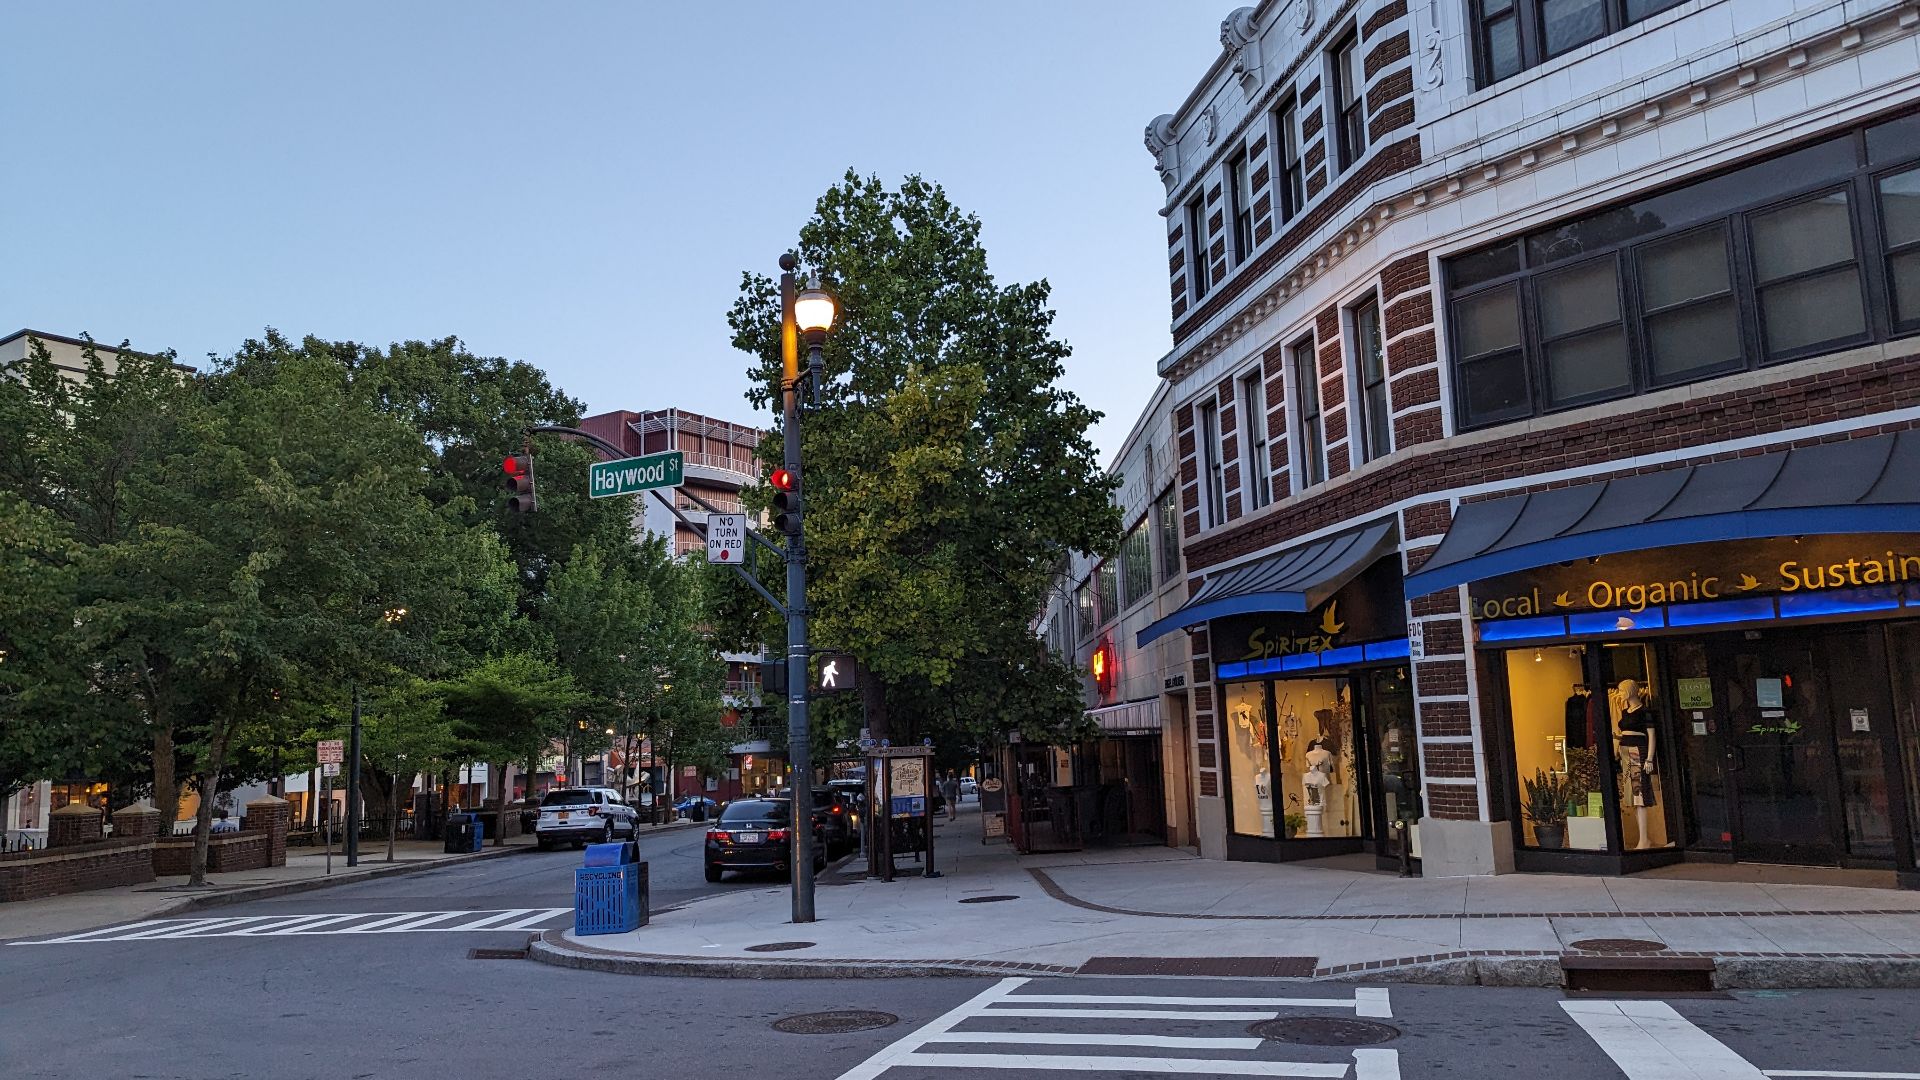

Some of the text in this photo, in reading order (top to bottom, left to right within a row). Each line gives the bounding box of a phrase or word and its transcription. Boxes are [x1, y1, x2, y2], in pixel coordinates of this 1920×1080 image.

[595, 458, 679, 492] Haywood St
[719, 517, 734, 527] NO
[715, 528, 738, 538] TURN
[709, 539, 742, 549] ON RED
[1468, 587, 1540, 620] Local
[1587, 572, 1719, 614] Organic
[1408, 622, 1422, 637] FDC
